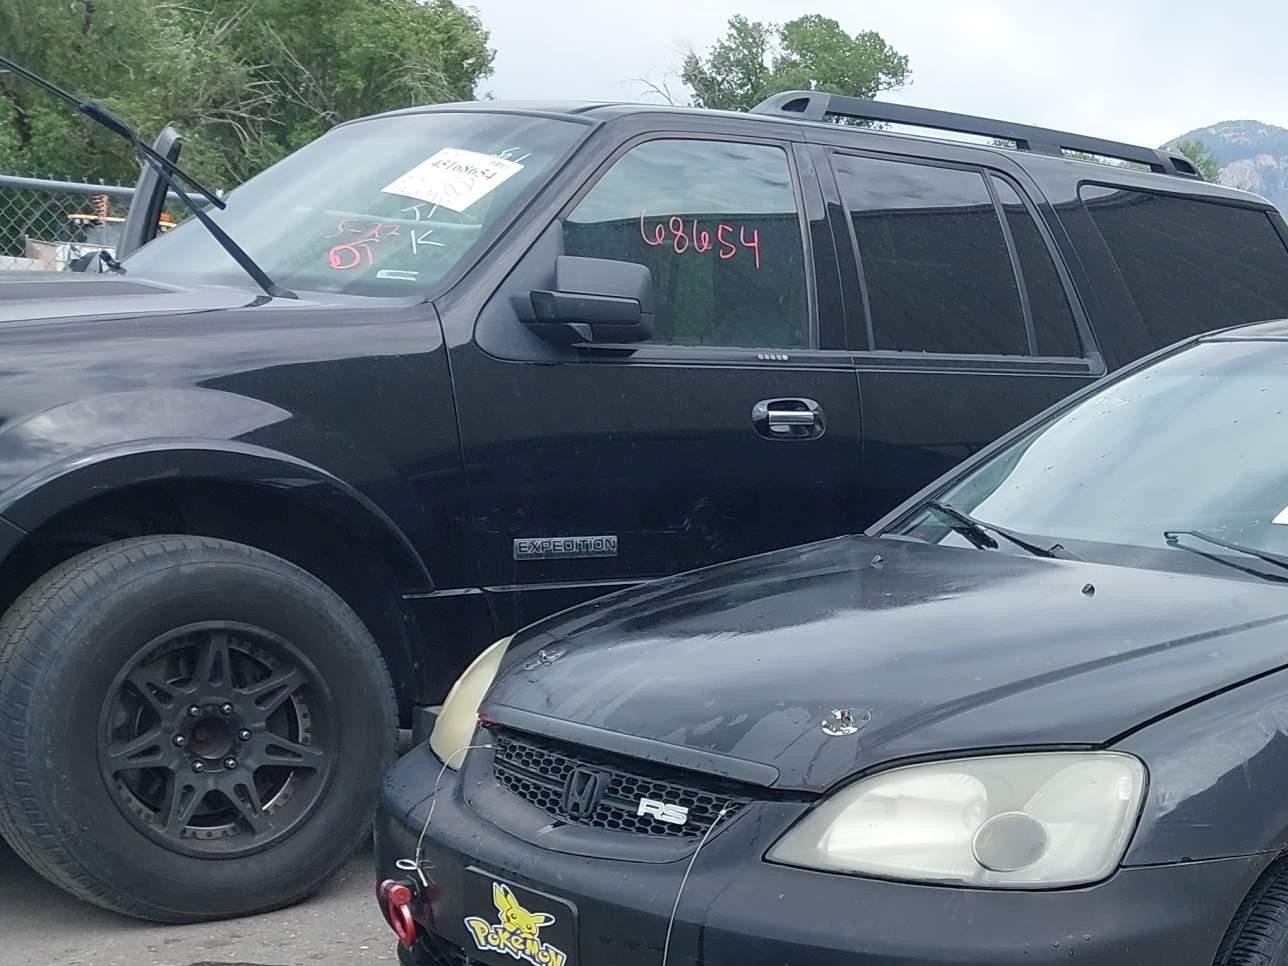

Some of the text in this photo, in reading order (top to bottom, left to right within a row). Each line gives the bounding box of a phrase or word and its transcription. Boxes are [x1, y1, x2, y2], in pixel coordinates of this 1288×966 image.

[431, 159, 498, 180] 45168654
[640, 208, 760, 270] 68654
[518, 539, 616, 553] EXPEDITION
[637, 798, 689, 825] RS
